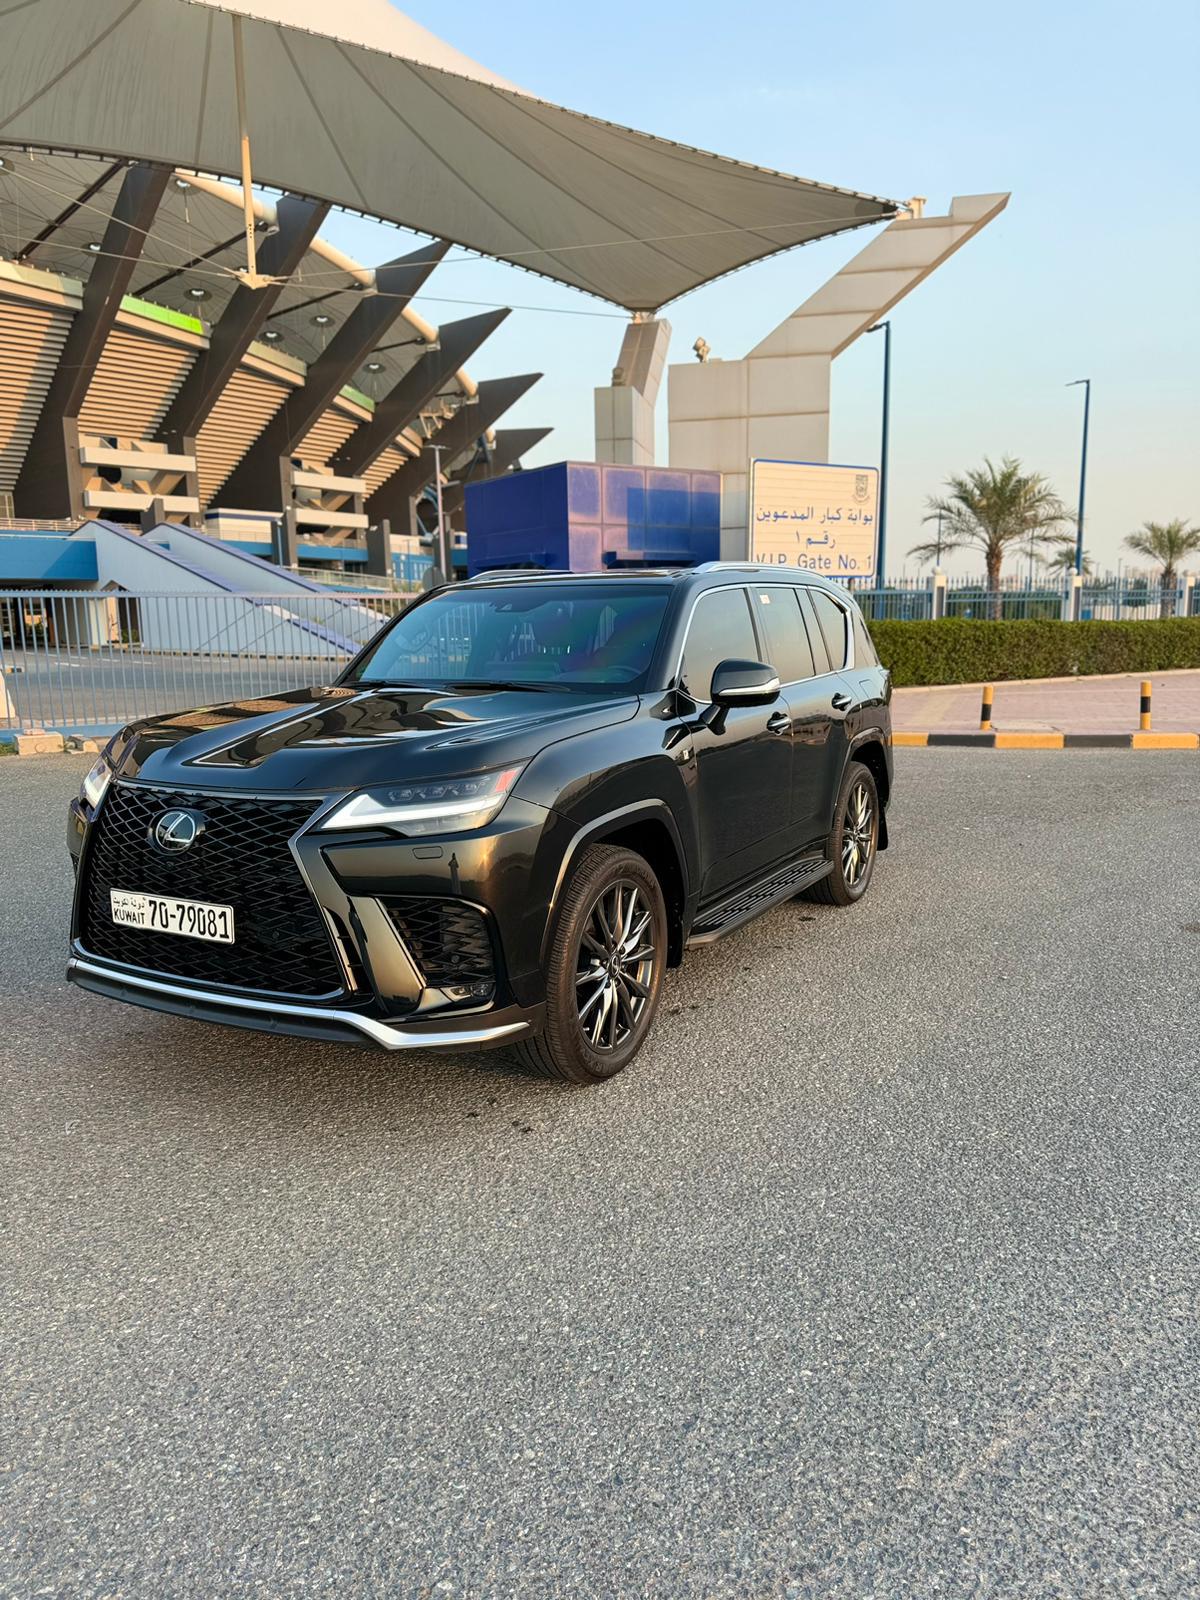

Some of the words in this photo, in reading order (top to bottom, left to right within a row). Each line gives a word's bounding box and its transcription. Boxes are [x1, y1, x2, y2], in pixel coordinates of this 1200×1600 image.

[756, 506, 814, 522] المدعوين
[819, 507, 842, 524] كبار
[847, 508, 873, 526] بوابة
[806, 531, 836, 548] رقم
[797, 553, 831, 570] Gate
[838, 554, 861, 570] No.
[113, 908, 145, 925] KUWAIT
[149, 900, 230, 939] 70-79081
